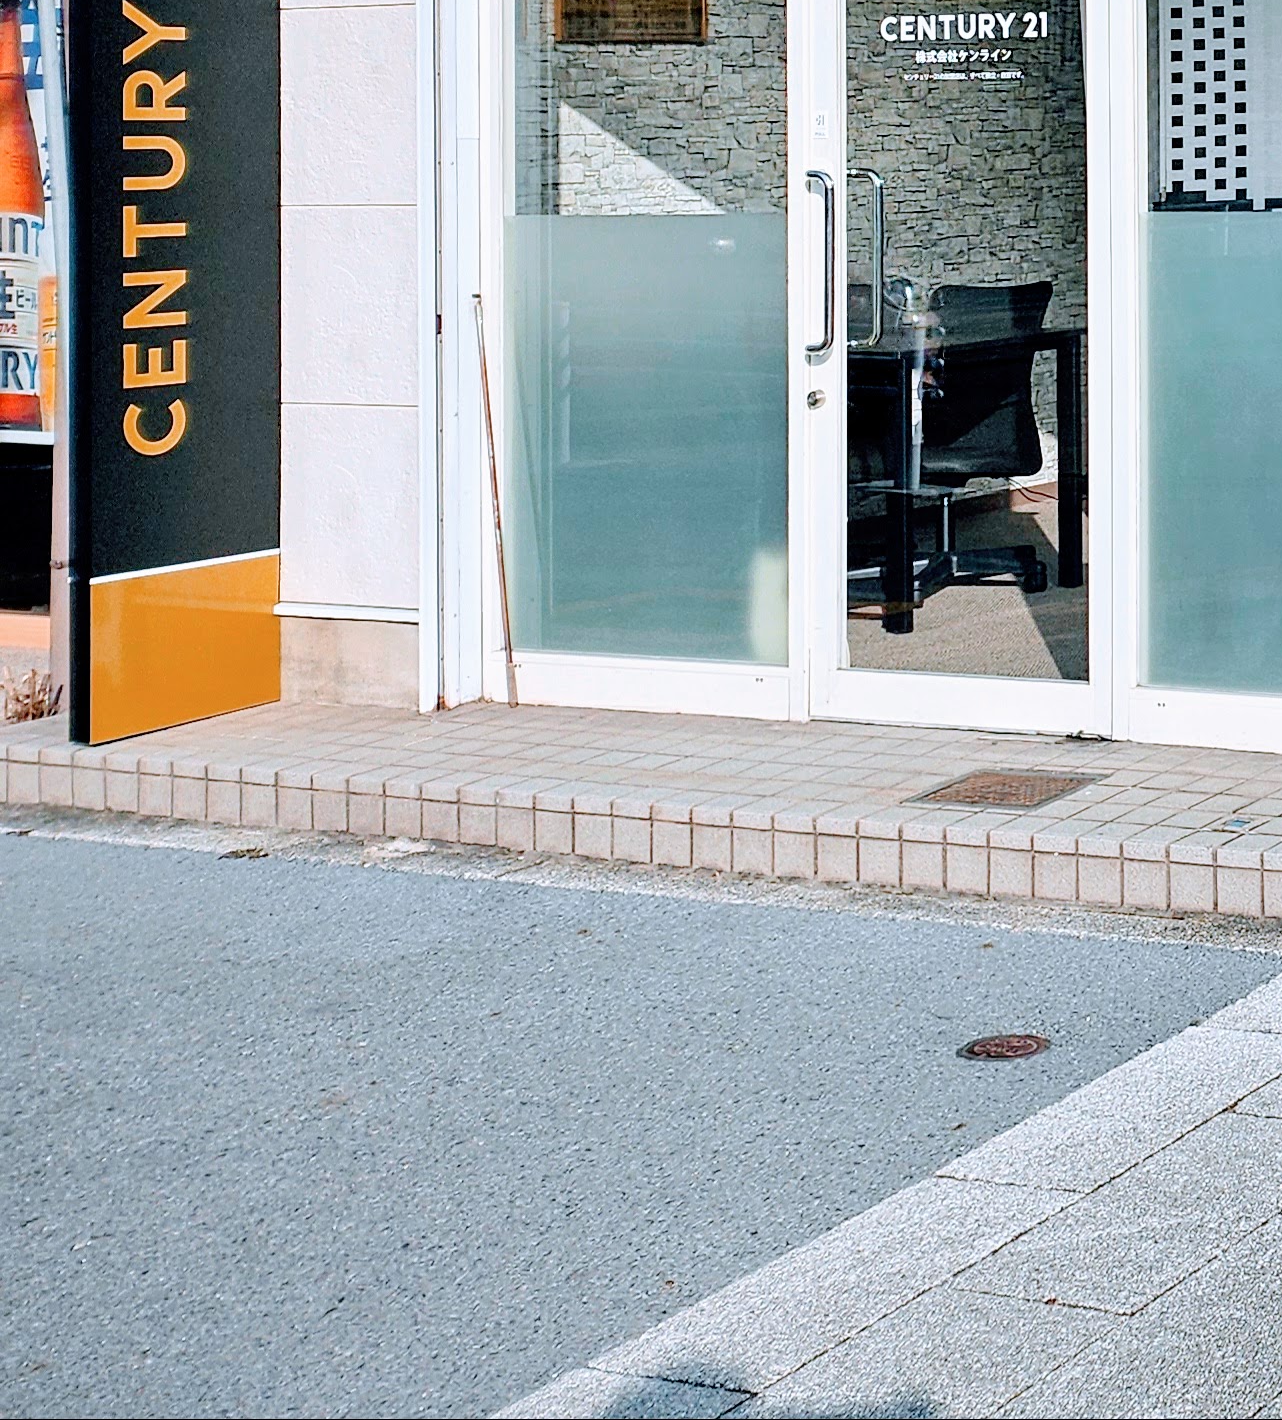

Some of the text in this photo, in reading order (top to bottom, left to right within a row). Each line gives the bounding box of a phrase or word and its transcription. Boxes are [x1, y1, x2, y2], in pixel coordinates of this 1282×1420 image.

[880, 11, 1049, 42] CENTURY 21
[915, 48, 1012, 64] 株式会社ケンライン
[122, 0, 188, 458] CENTURY
